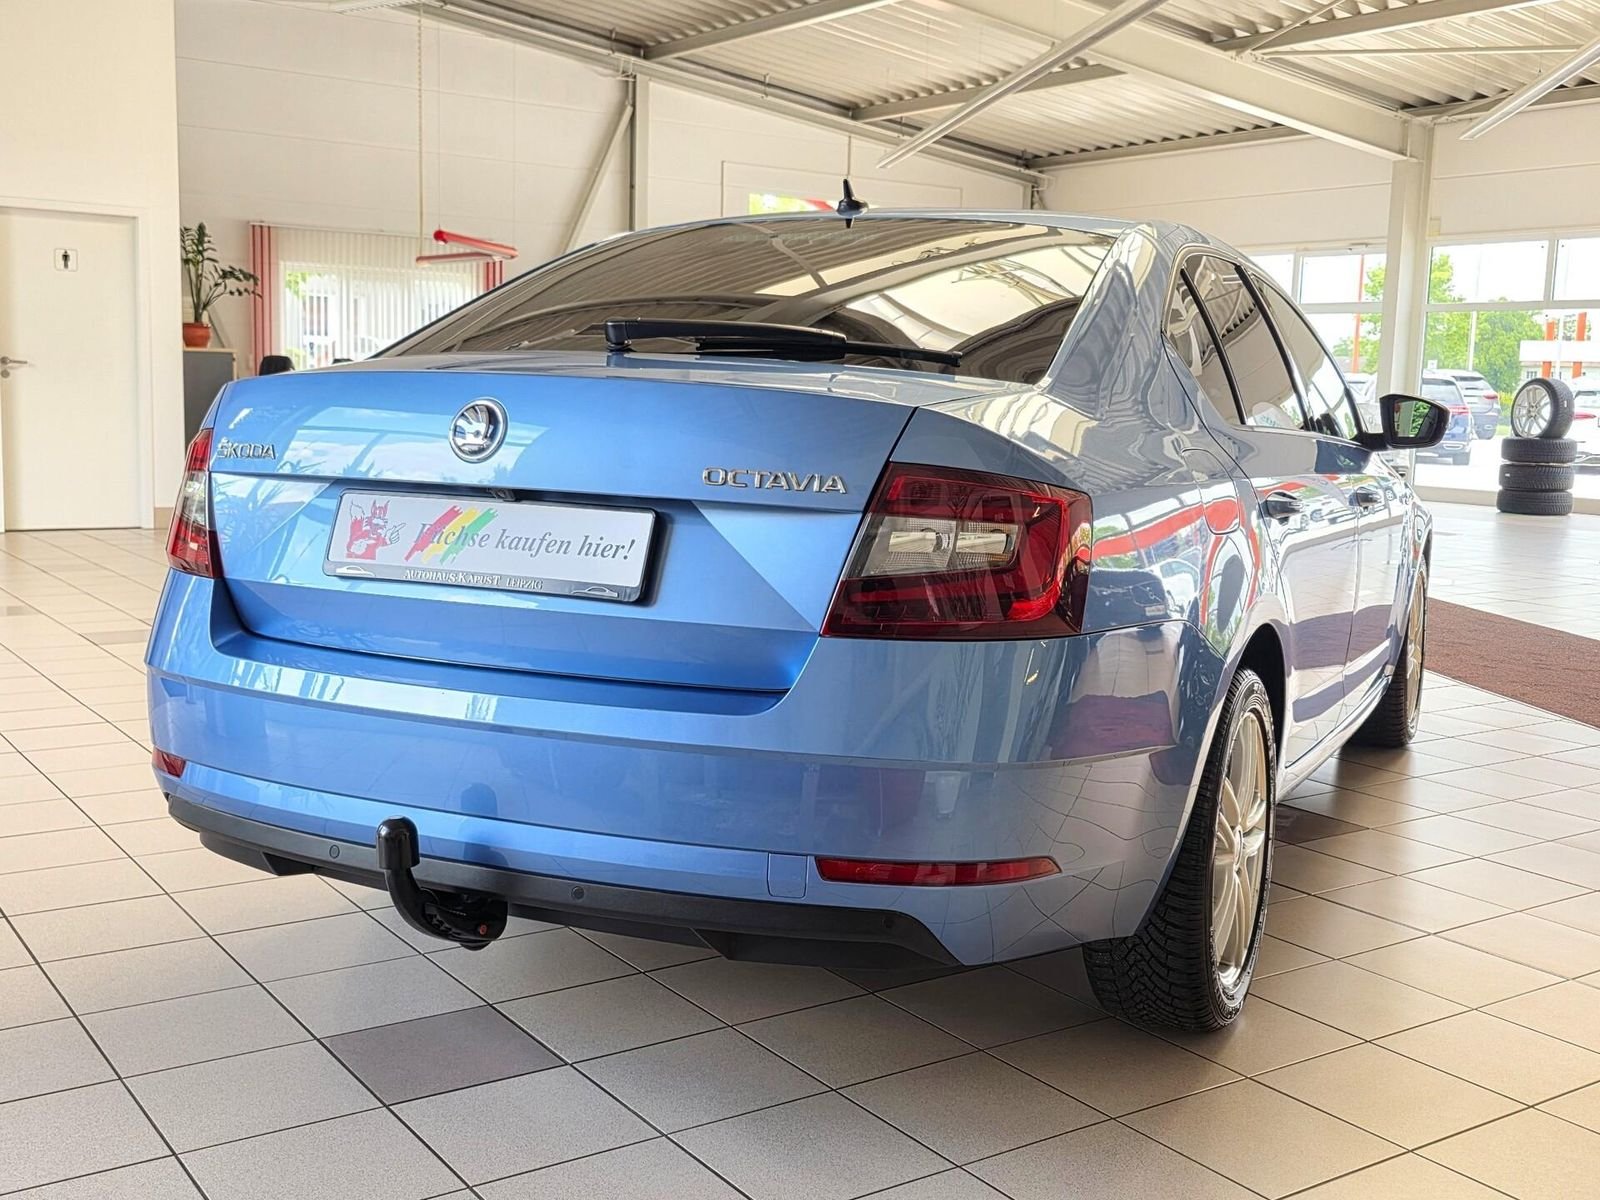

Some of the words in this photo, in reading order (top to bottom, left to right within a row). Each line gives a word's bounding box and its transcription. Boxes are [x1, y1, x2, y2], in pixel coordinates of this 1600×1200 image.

[217, 437, 276, 460] ŠKODA
[702, 467, 847, 495] OCTAVIA
[495, 528, 572, 558] kaufen
[577, 535, 636, 560] hier!
[506, 577, 543, 590] LEIPZIG
